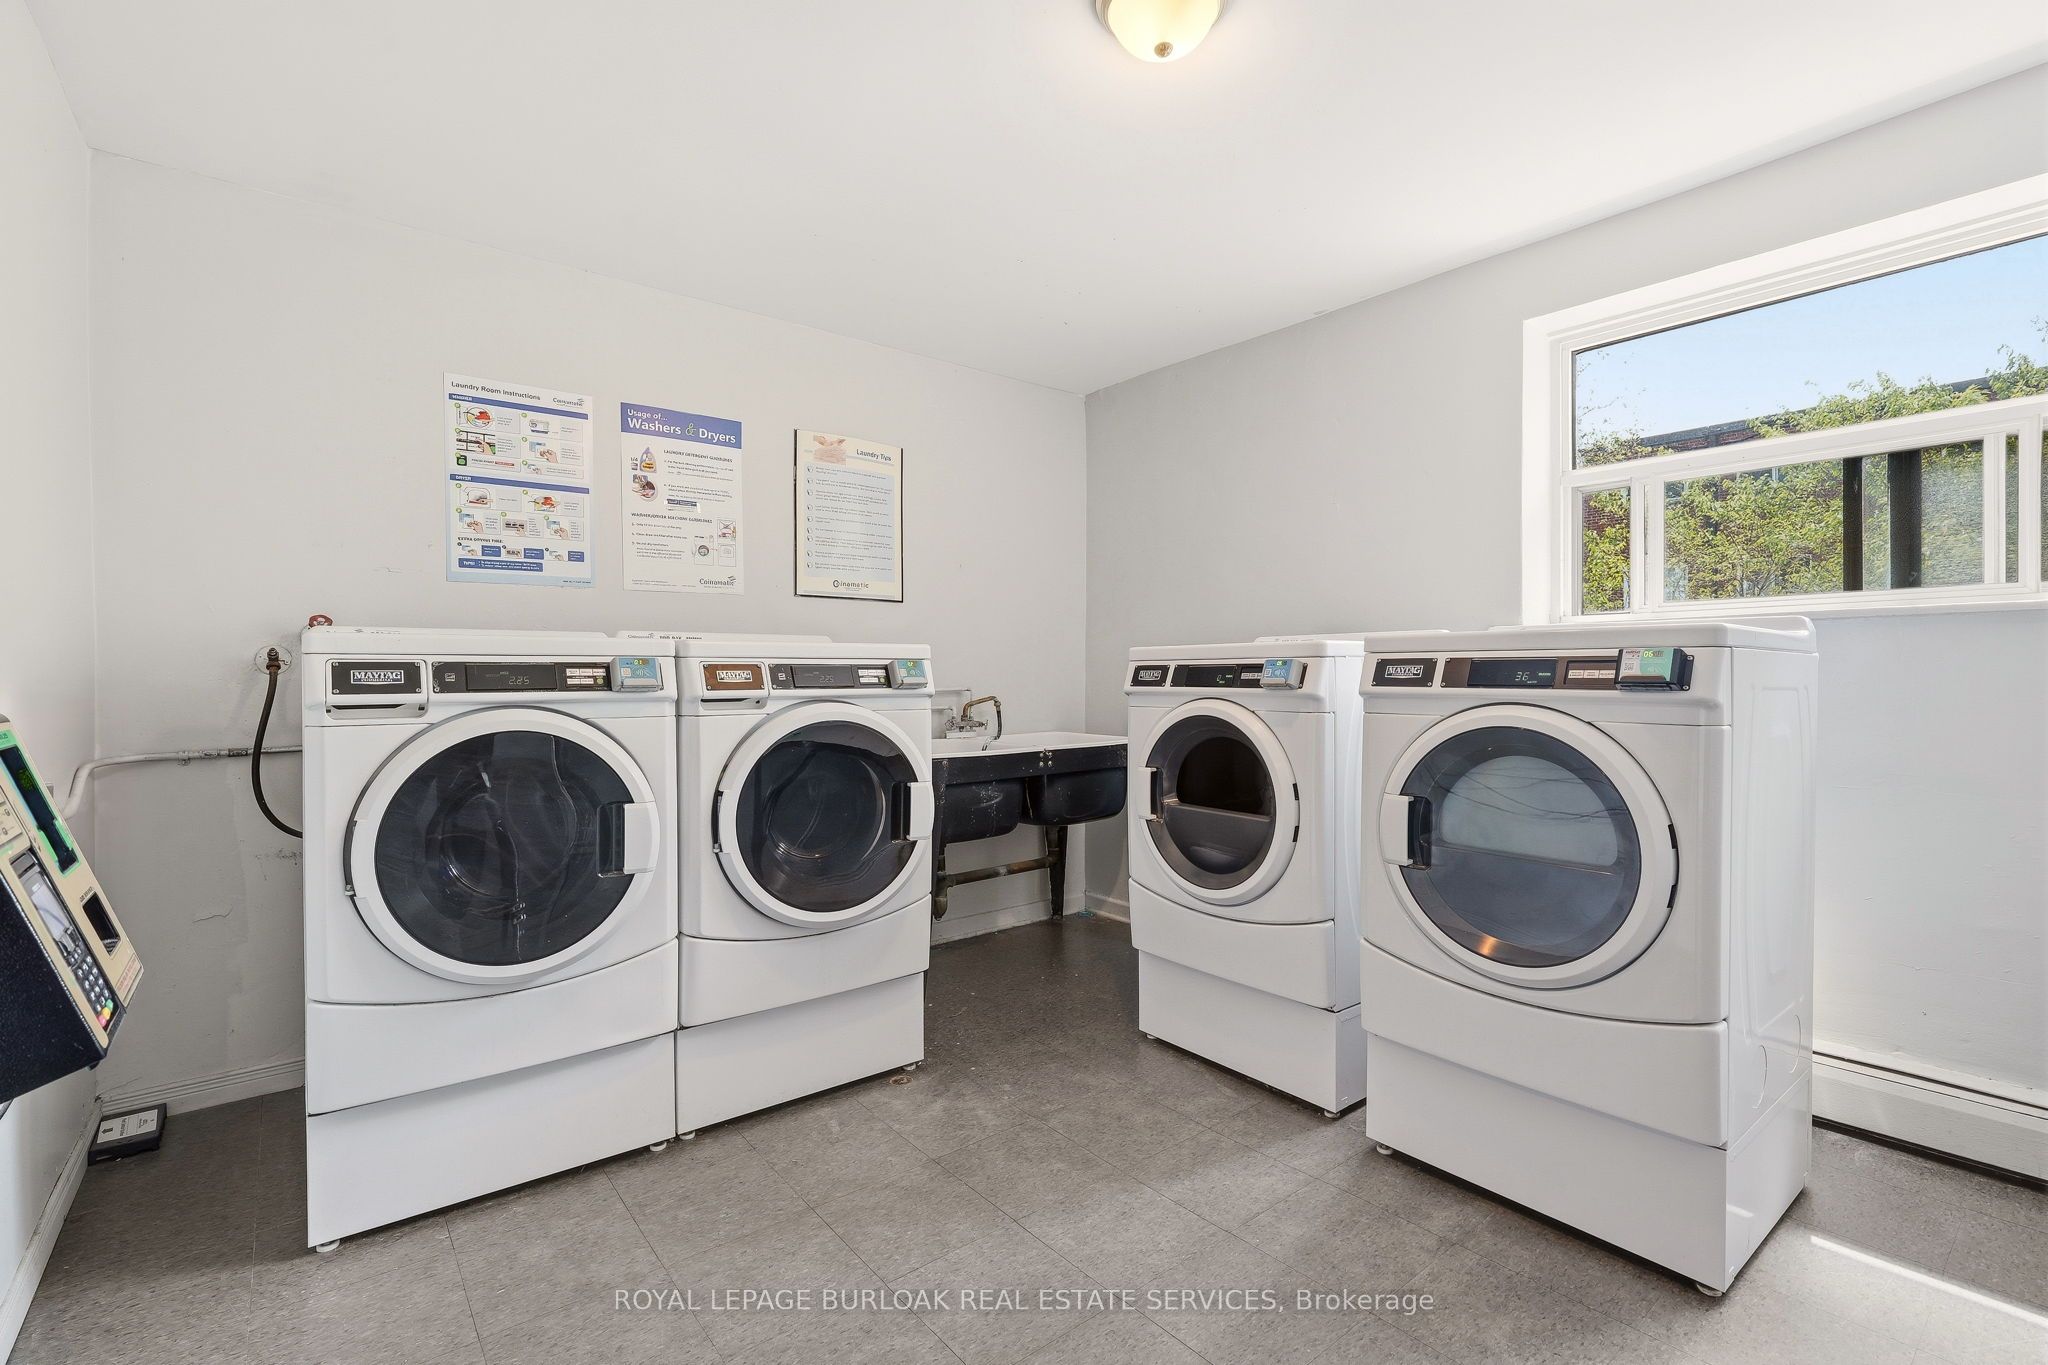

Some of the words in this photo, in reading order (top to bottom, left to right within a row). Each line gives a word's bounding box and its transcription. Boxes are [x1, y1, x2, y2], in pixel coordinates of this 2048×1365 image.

[451, 381, 480, 391] Laundry
[481, 386, 502, 394] Room
[502, 389, 541, 400] Instructions
[627, 409, 652, 419] Usage
[628, 417, 682, 434] Washers
[685, 423, 697, 436] &
[699, 428, 736, 444] Dryers
[856, 448, 879, 460] Laundry
[880, 453, 892, 462] Tips
[1387, 666, 1421, 674] MAYTAG
[353, 671, 401, 680] MAYTAG
[1515, 671, 1530, 681] 36
